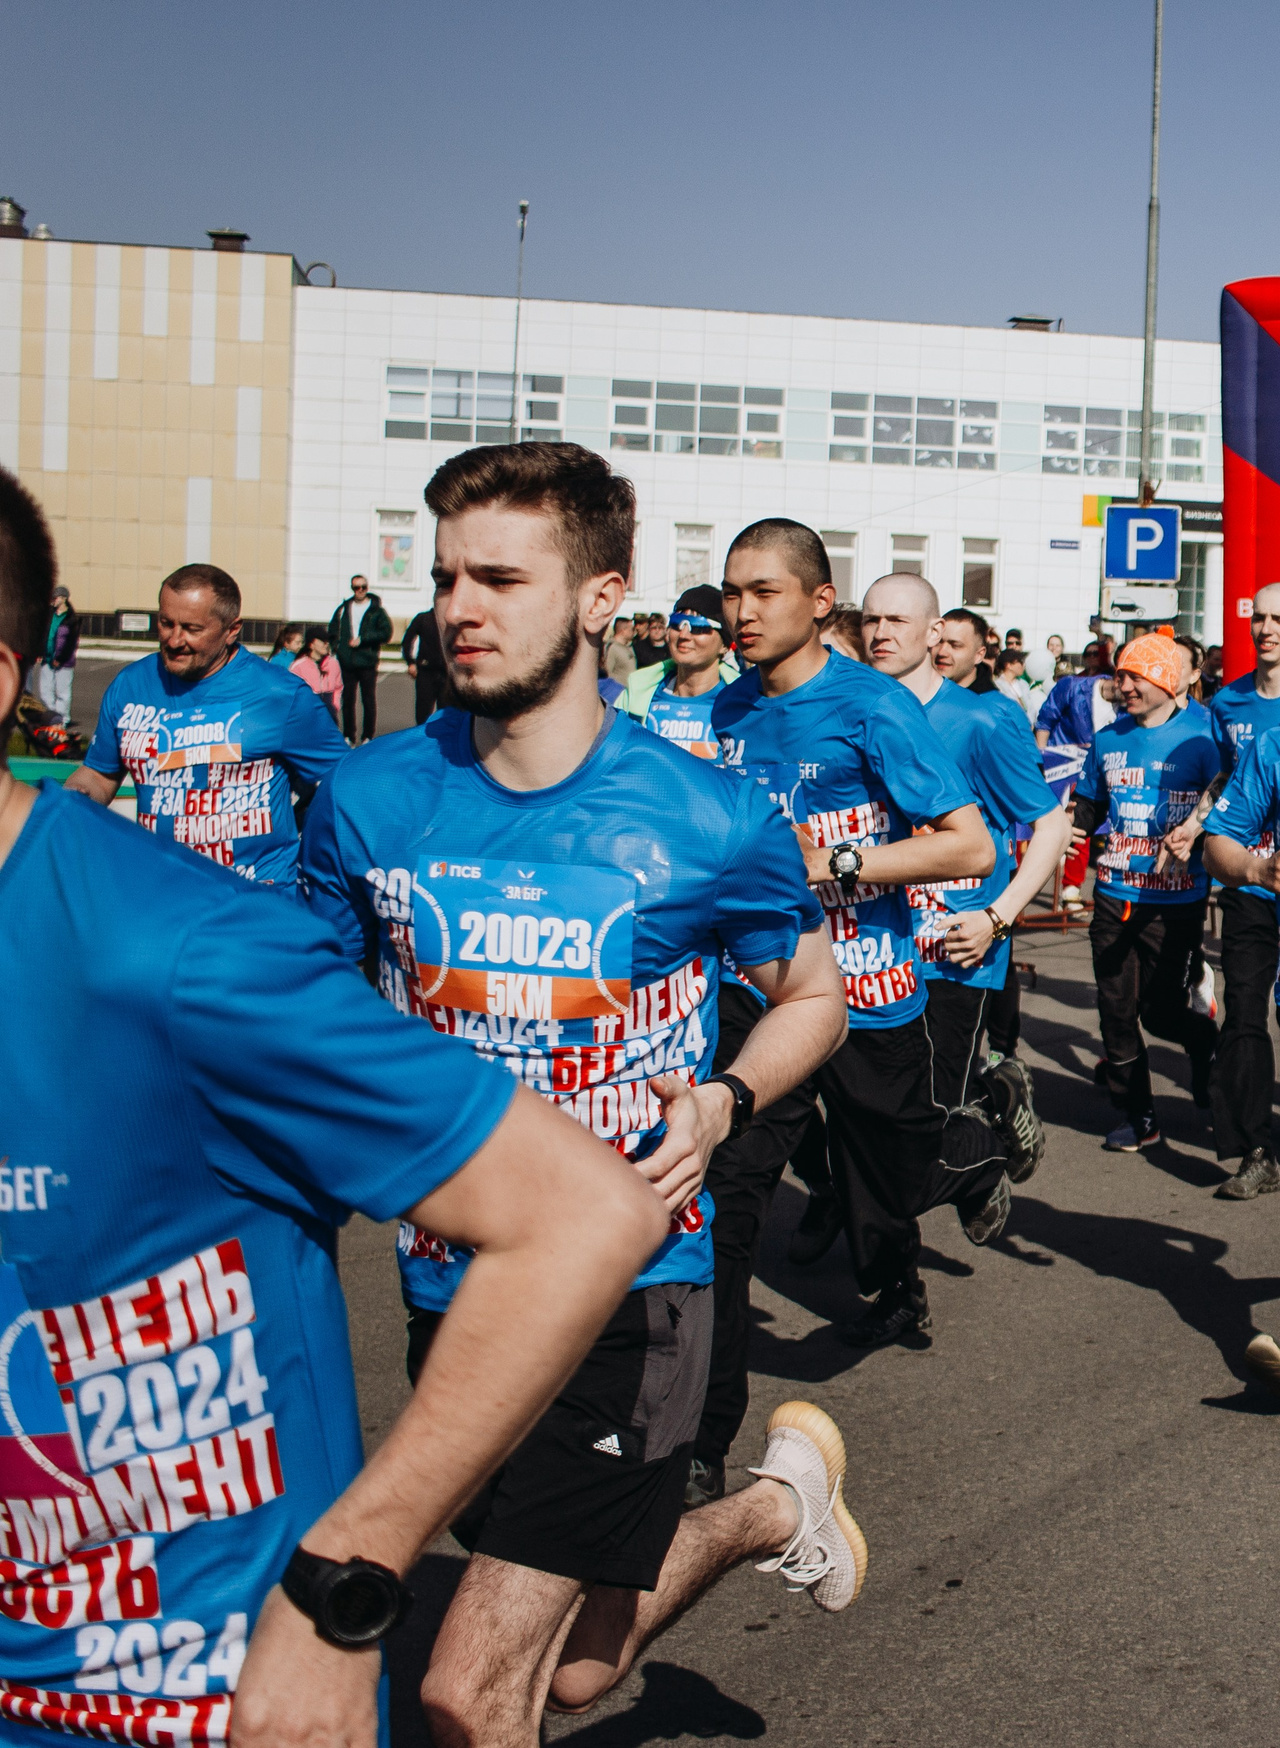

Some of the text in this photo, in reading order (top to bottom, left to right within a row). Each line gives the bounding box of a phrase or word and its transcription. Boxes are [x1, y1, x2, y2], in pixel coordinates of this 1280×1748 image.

[1127, 518, 1164, 571] P
[173, 721, 225, 749] 20008
[660, 719, 704, 740] 20010
[208, 757, 275, 788] #ЦЕЛЬ
[1103, 751, 1128, 771] 2024
[174, 806, 273, 844] #МОМЕНТ
[807, 801, 891, 848] #ЦЕЛЬ
[1120, 802, 1156, 821] 40004
[1168, 804, 1192, 822] 202
[449, 864, 482, 880] ПСБ
[365, 867, 414, 924] 20
[459, 910, 593, 971] 20023
[833, 932, 895, 976] 2024
[594, 961, 708, 1044] #ЦЕЛЬ
[72, 1326, 269, 1476] 2024
[593, 1441, 623, 1457] adidas
[74, 1612, 248, 1698] 2024
